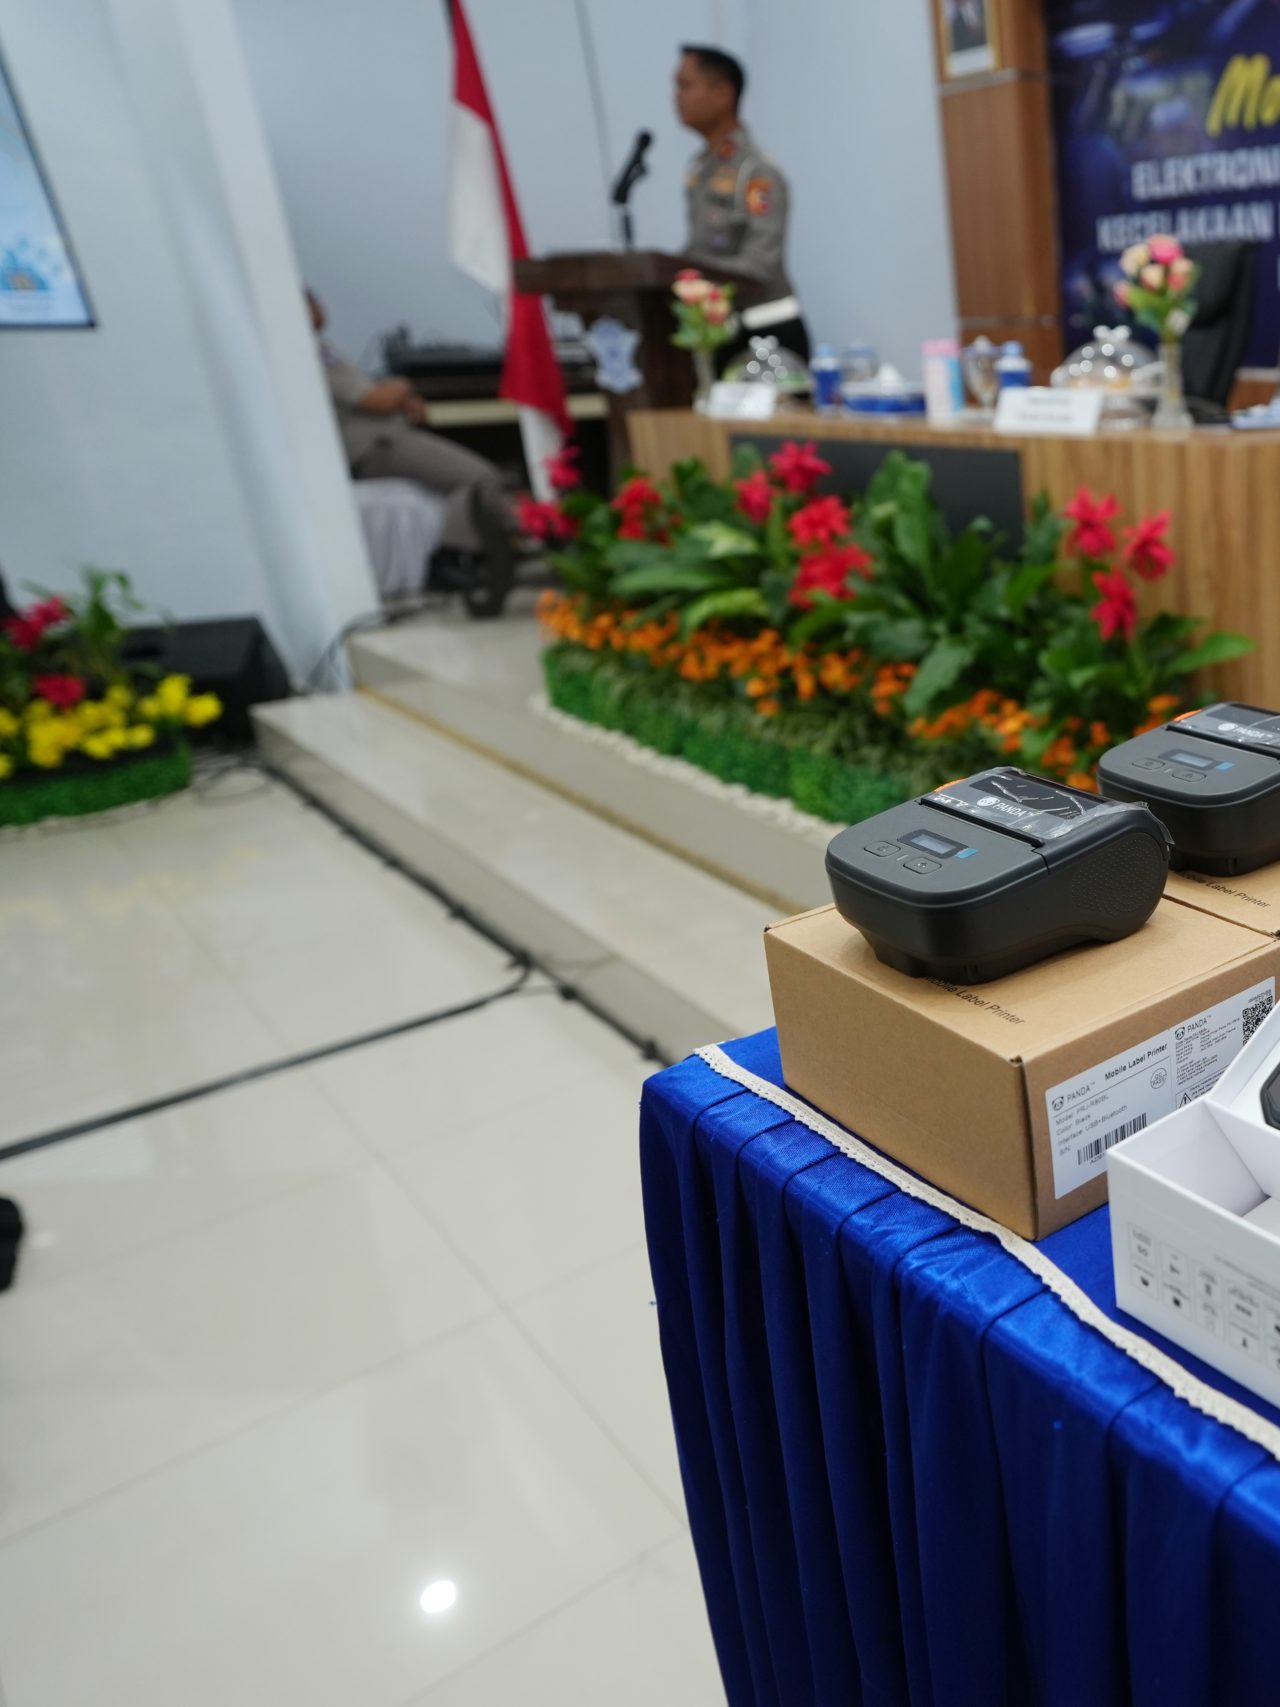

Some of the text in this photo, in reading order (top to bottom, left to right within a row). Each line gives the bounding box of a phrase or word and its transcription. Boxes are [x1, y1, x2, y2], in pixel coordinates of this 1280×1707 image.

[993, 802, 1027, 817] PANDA
[1206, 881, 1271, 908] Label Printer
[956, 990, 988, 1007] Label
[985, 1004, 1025, 1024] Printer
[1187, 1017, 1207, 1032] PANDA
[1104, 1065, 1127, 1080] Mobile
[1128, 1055, 1146, 1069] Label
[1147, 1043, 1168, 1059] Printer
[1066, 1084, 1091, 1102] PANDA
